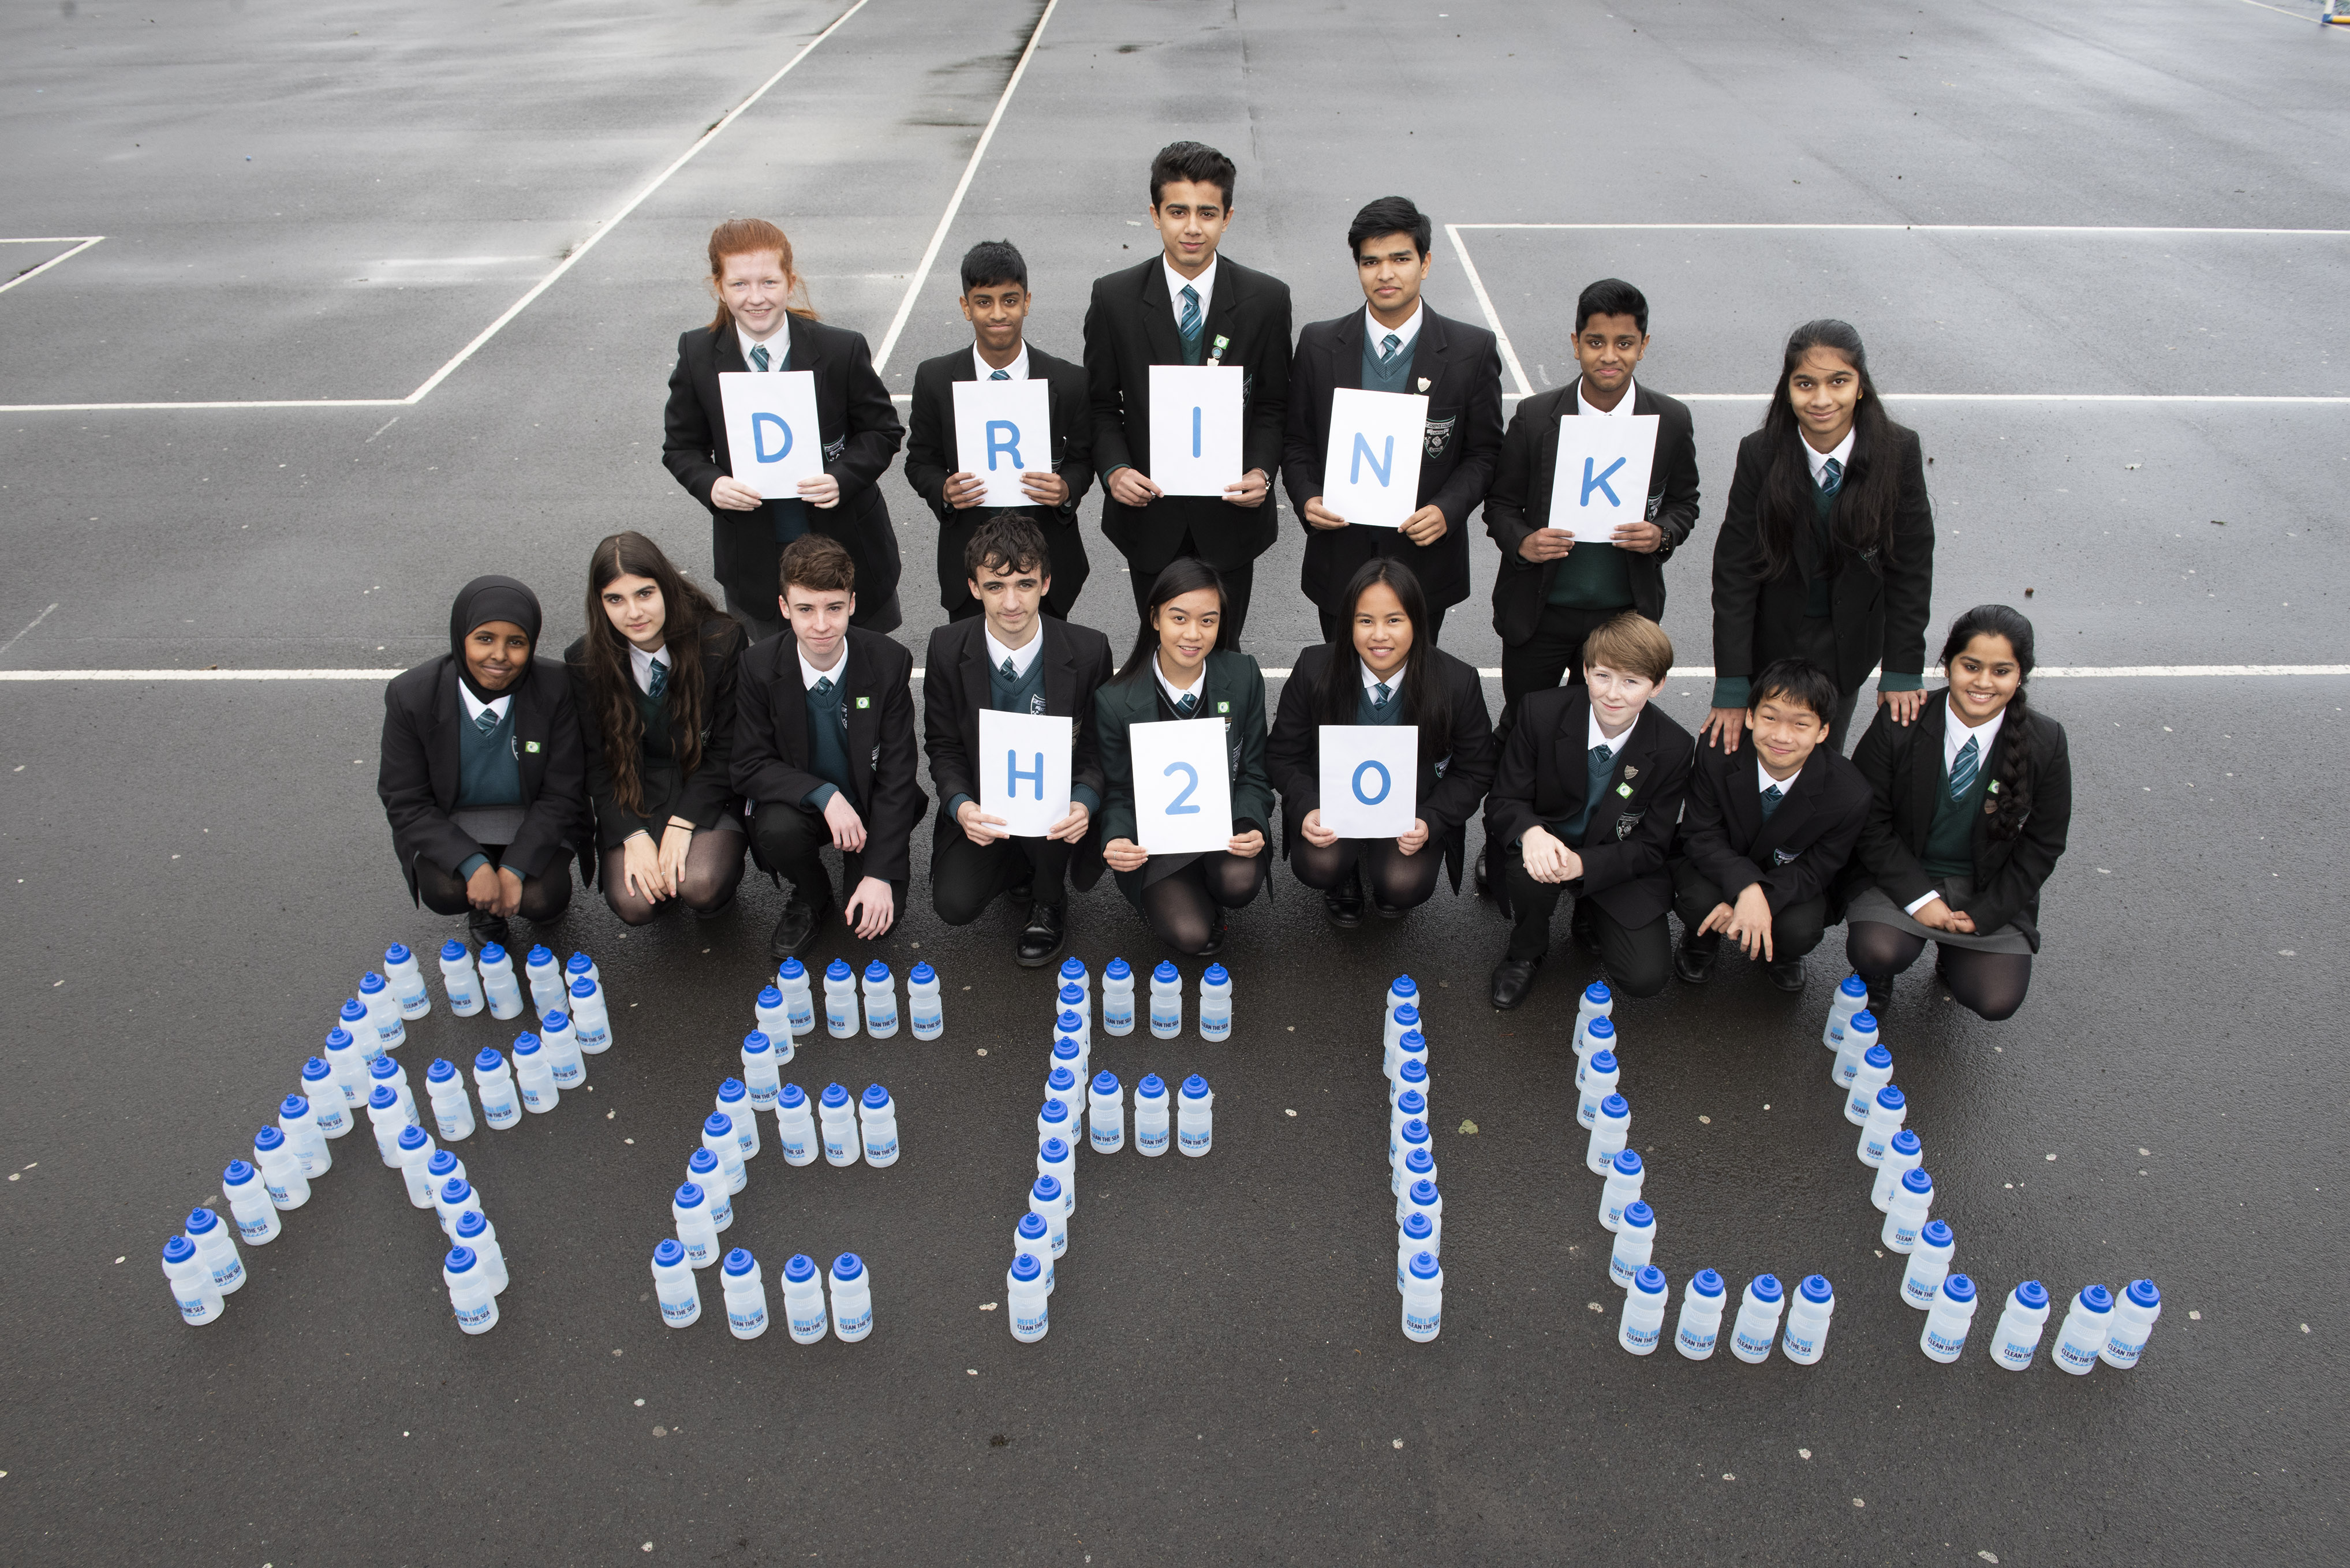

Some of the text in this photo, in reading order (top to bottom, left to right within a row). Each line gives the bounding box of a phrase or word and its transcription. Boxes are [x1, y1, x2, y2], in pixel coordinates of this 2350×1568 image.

[752, 413, 793, 463] D
[1193, 407, 1201, 458] I
[986, 420, 1024, 471] R
[1351, 433, 1393, 487] N
[1581, 457, 1626, 507] K
[1008, 750, 1043, 800] H
[1165, 763, 1200, 814] 2
[1105, 1016, 1115, 1024] CLEAN
[1152, 1019, 1163, 1027] CLEAN
[1201, 1021, 1212, 1030] CLEAN
[780, 1046, 789, 1054] SEA
[1851, 1104, 1865, 1113] CLEAN
[1107, 1127, 1119, 1136] FREE
[1180, 1129, 1209, 1140] REFILL FREE
[1180, 1135, 1191, 1145] CLEAN
[829, 1142, 843, 1150] FREE
[866, 1143, 883, 1151] REFILL
[1867, 1147, 1882, 1157] CLEAN
[690, 1243, 705, 1252] FREE
[1056, 1239, 1064, 1247] SEA
[1612, 1261, 1623, 1274] CLEAN
[223, 1273, 234, 1281] THE
[1907, 1283, 1922, 1296] CLEAN
[1910, 1277, 1929, 1292] REFILL
[185, 1298, 203, 1308] FREE
[680, 1296, 694, 1309] FREE
[472, 1303, 488, 1316] FREE
[480, 1311, 490, 1319] SEA
[662, 1307, 675, 1316] CLEAN
[686, 1303, 696, 1313] SEA
[749, 1307, 763, 1320] FREE
[730, 1318, 744, 1327] CLEAN
[756, 1314, 764, 1322] SEA
[840, 1317, 860, 1325] REFILL
[1407, 1313, 1427, 1324] REFILL
[857, 1320, 866, 1329] THE
[1034, 1320, 1043, 1329] THE
[1407, 1320, 1422, 1330] CLEAN
[1626, 1332, 1642, 1343] CLEAN
[1628, 1326, 1649, 1338] REFILL
[1682, 1327, 1701, 1342] REFILL
[1680, 1334, 1695, 1347] CLEAN
[1739, 1331, 1759, 1346] REFILL
[1796, 1337, 1814, 1348] FREE
[1928, 1337, 1944, 1350] CLEAN
[1930, 1330, 1950, 1346] REFILL
[1737, 1338, 1753, 1351] CLEAN
[1791, 1340, 1799, 1350] THE
[2007, 1342, 2029, 1353] REFILL
[2064, 1341, 2084, 1357] REFILL
[2108, 1343, 2125, 1356] CLEAN
[2110, 1337, 2132, 1352] REFILL
[2004, 1348, 2022, 1359] CLEAN
[2061, 1348, 2078, 1361] CLEAN
